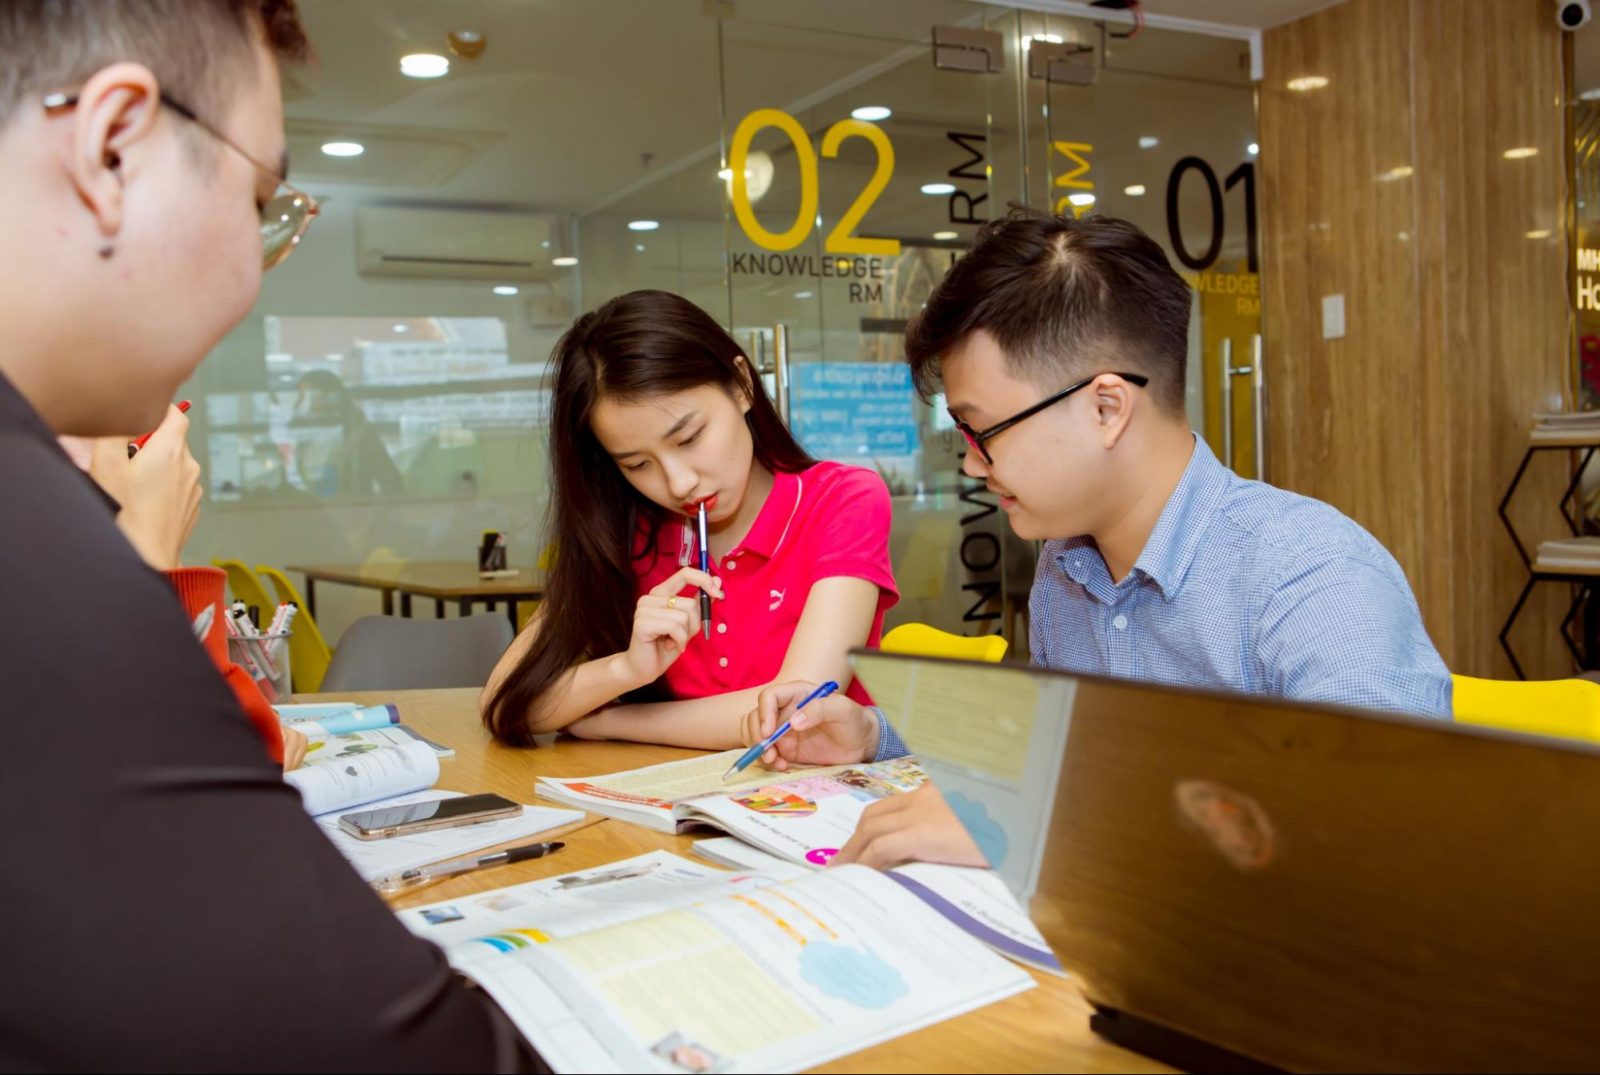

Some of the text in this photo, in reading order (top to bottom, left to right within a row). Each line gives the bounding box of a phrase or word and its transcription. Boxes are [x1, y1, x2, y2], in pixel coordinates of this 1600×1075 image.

[729, 108, 901, 256] 02
[947, 132, 989, 225] RM
[1166, 156, 1259, 273] 01
[733, 253, 883, 278] KNOWLEDGE
[849, 283, 883, 303] RM
